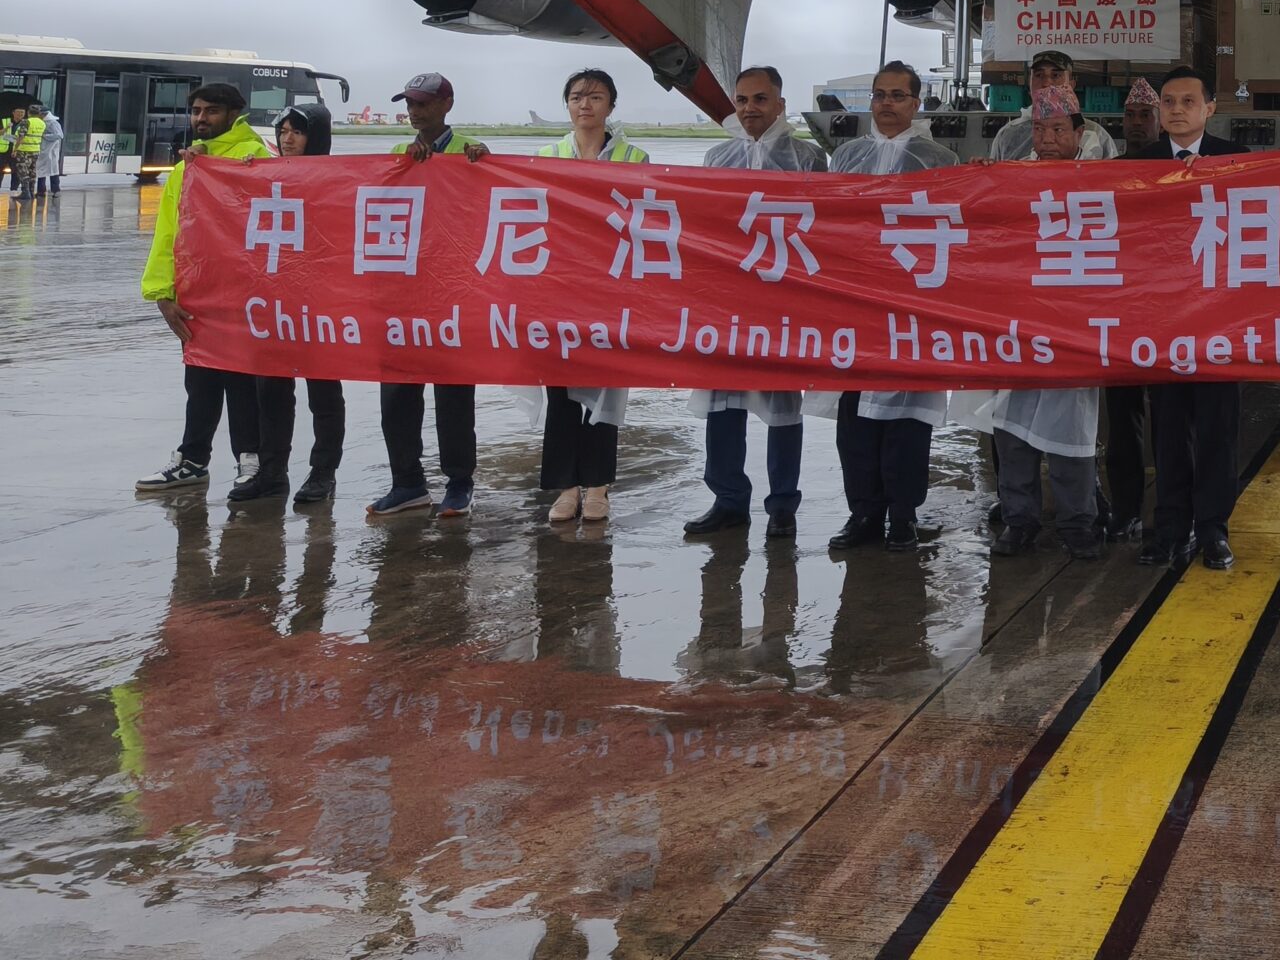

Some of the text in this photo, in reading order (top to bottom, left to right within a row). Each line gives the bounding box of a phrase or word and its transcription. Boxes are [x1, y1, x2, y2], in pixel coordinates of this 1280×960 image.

[1016, 10, 1157, 31] CHINA AID
[1017, 32, 1154, 45] FOR SHARED FUTURE
[252, 68, 280, 77] COBUS
[245, 296, 360, 345] China
[386, 304, 461, 349] and
[489, 303, 630, 360] Nepal
[660, 306, 857, 370] Joining
[888, 313, 1055, 364] Hands
